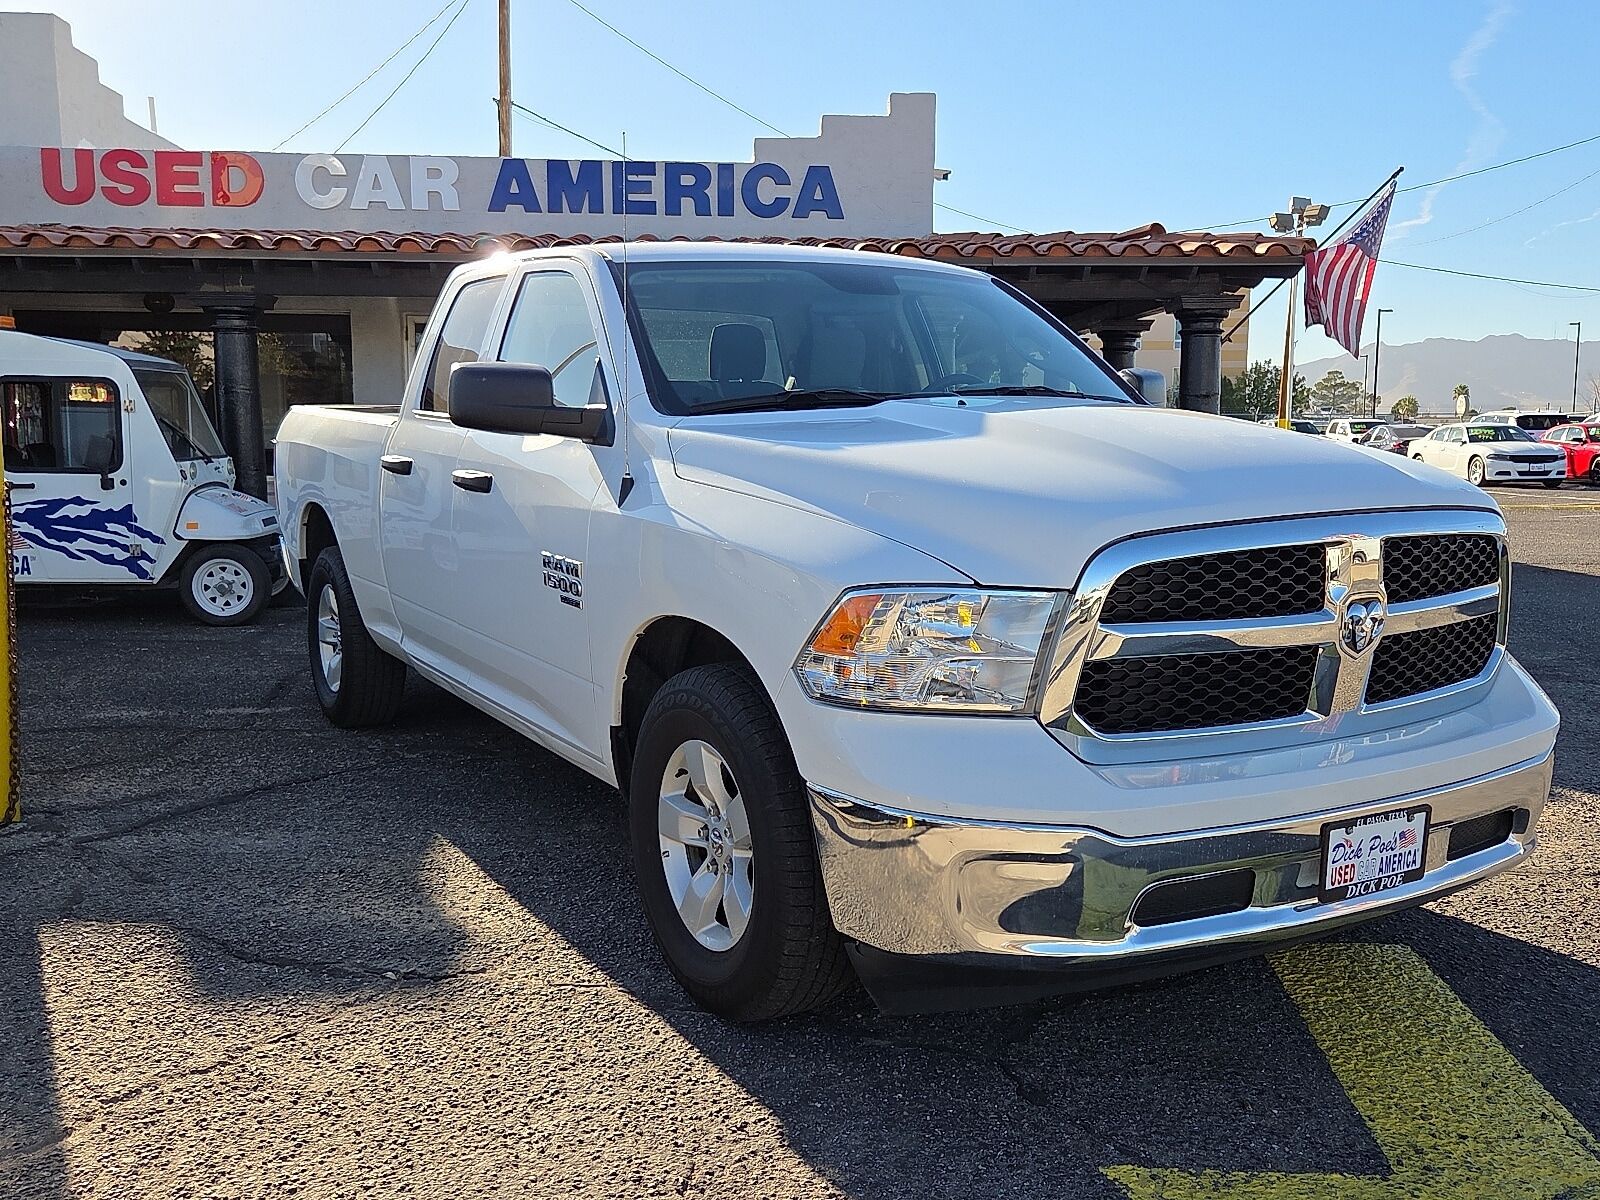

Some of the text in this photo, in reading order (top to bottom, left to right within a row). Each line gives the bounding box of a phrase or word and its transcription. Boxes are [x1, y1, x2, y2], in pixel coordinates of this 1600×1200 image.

[41, 147, 844, 219] USED CAR AMERICA
[541, 550, 583, 579] RAM
[542, 570, 583, 597] 1500
[1389, 810, 1408, 821] TEXAS
[1331, 830, 1399, 865] Dick Poe's
[1330, 848, 1417, 887] USED CAR AMERICA
[1345, 873, 1405, 899] DICK POE
